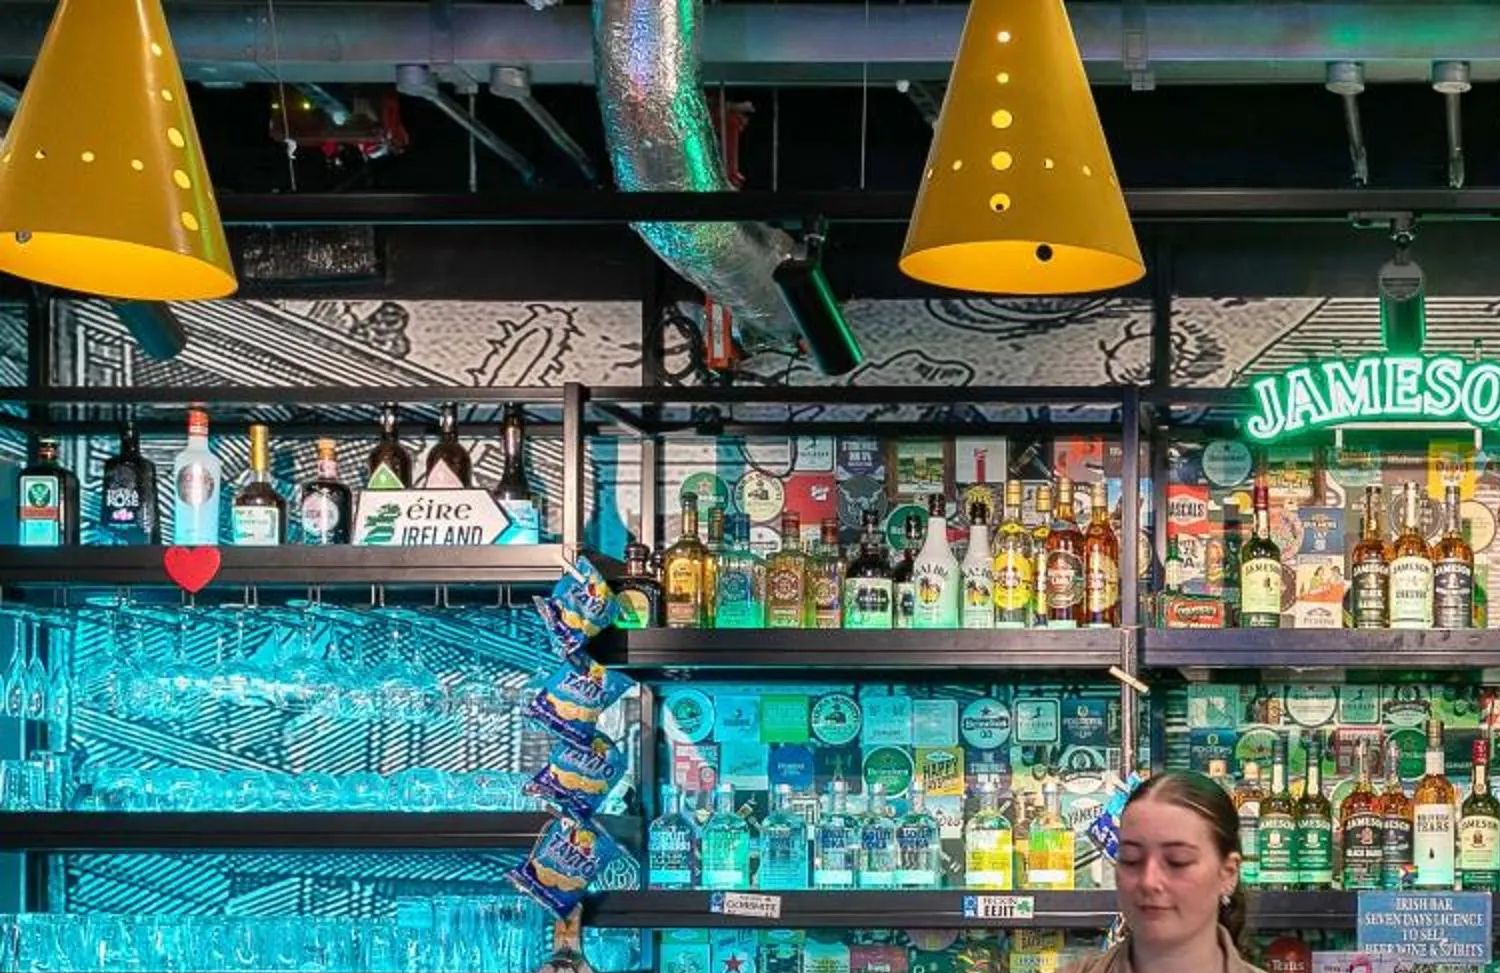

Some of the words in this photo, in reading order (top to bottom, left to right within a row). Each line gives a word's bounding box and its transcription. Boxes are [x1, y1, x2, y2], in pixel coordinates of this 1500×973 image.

[407, 498, 472, 520] éire
[1346, 817, 1383, 830] JAMESON
[1396, 898, 1425, 910] IRISH
[1427, 898, 1454, 910] BAR
[984, 906, 1014, 917] EEJIT
[1365, 913, 1400, 926] SEVEN
[1402, 913, 1432, 926] DAYS
[1433, 913, 1484, 926] LICENCE
[1403, 928, 1418, 940] TO
[1420, 928, 1445, 941] SELL
[1396, 943, 1426, 956] WINE
